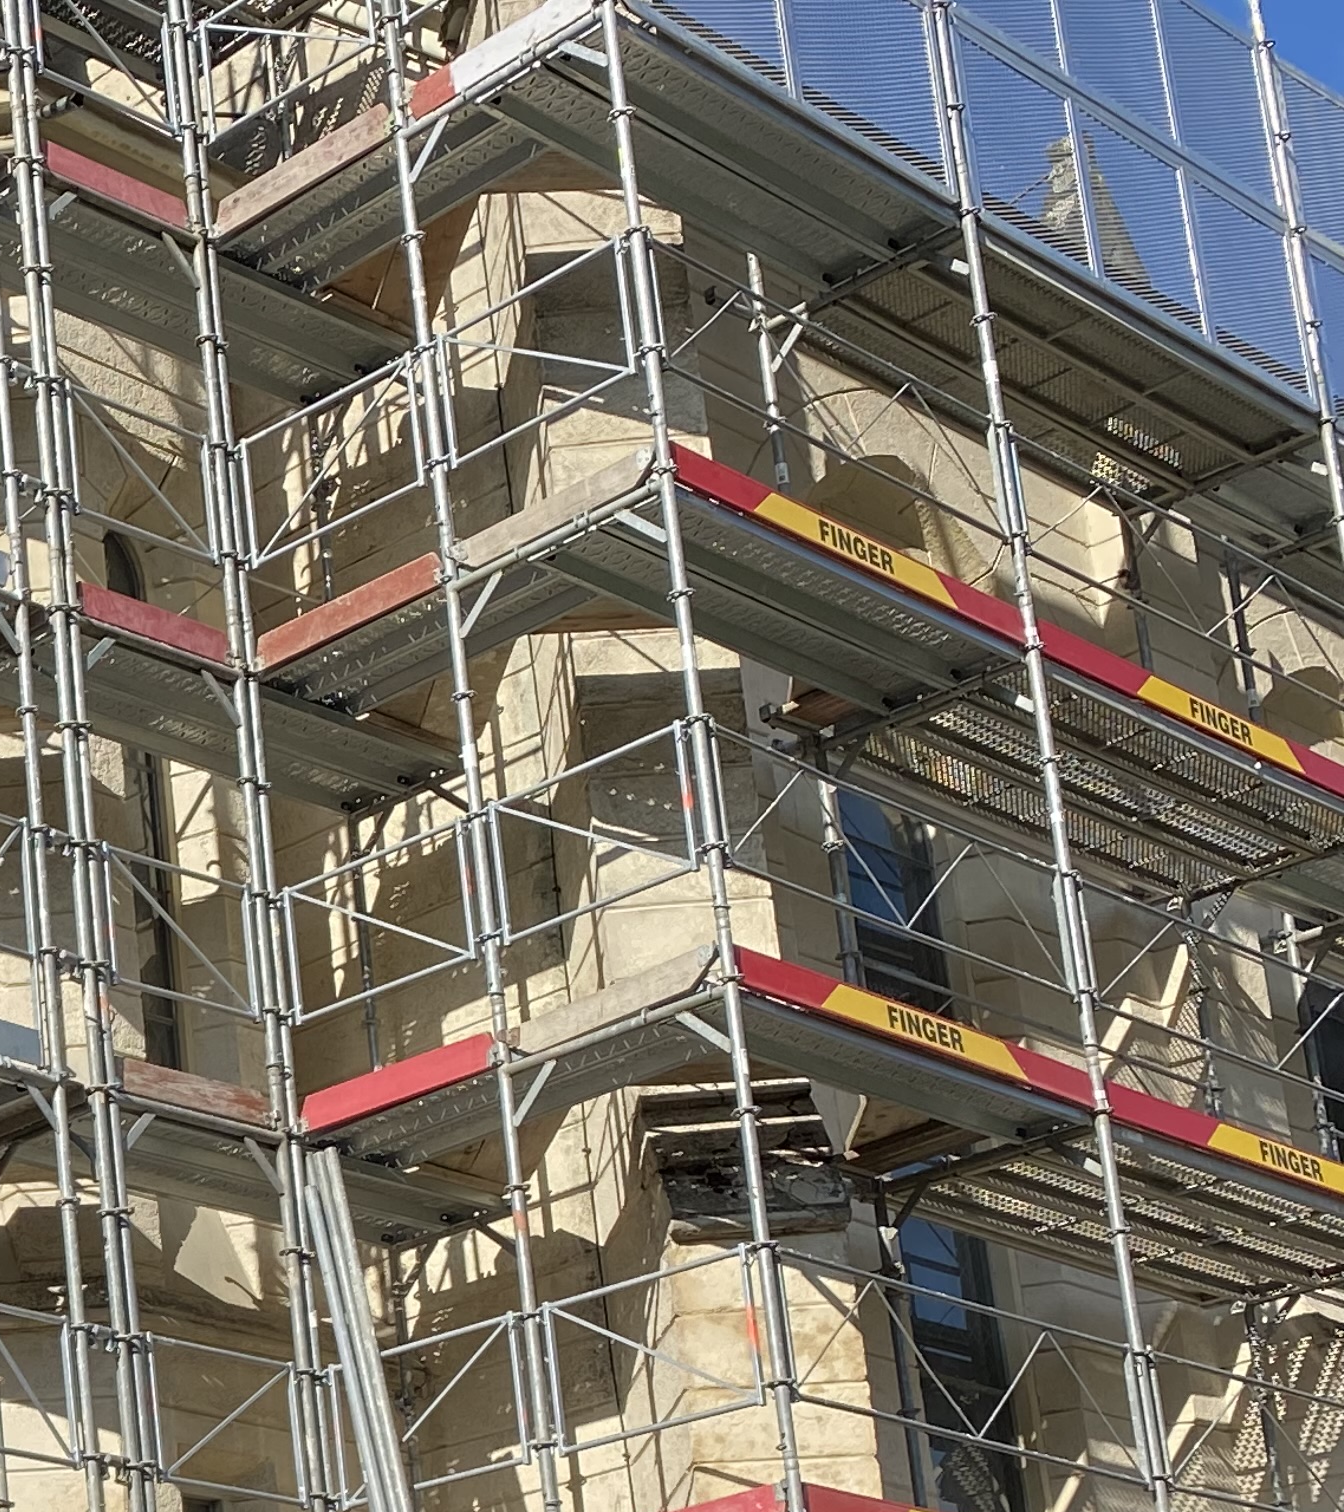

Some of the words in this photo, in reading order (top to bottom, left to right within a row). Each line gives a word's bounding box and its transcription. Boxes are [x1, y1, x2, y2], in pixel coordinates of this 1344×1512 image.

[818, 518, 896, 575] FINGER
[1189, 697, 1254, 746] FINGER
[887, 1005, 965, 1053] FINGER
[1259, 1140, 1324, 1182] FINGER
